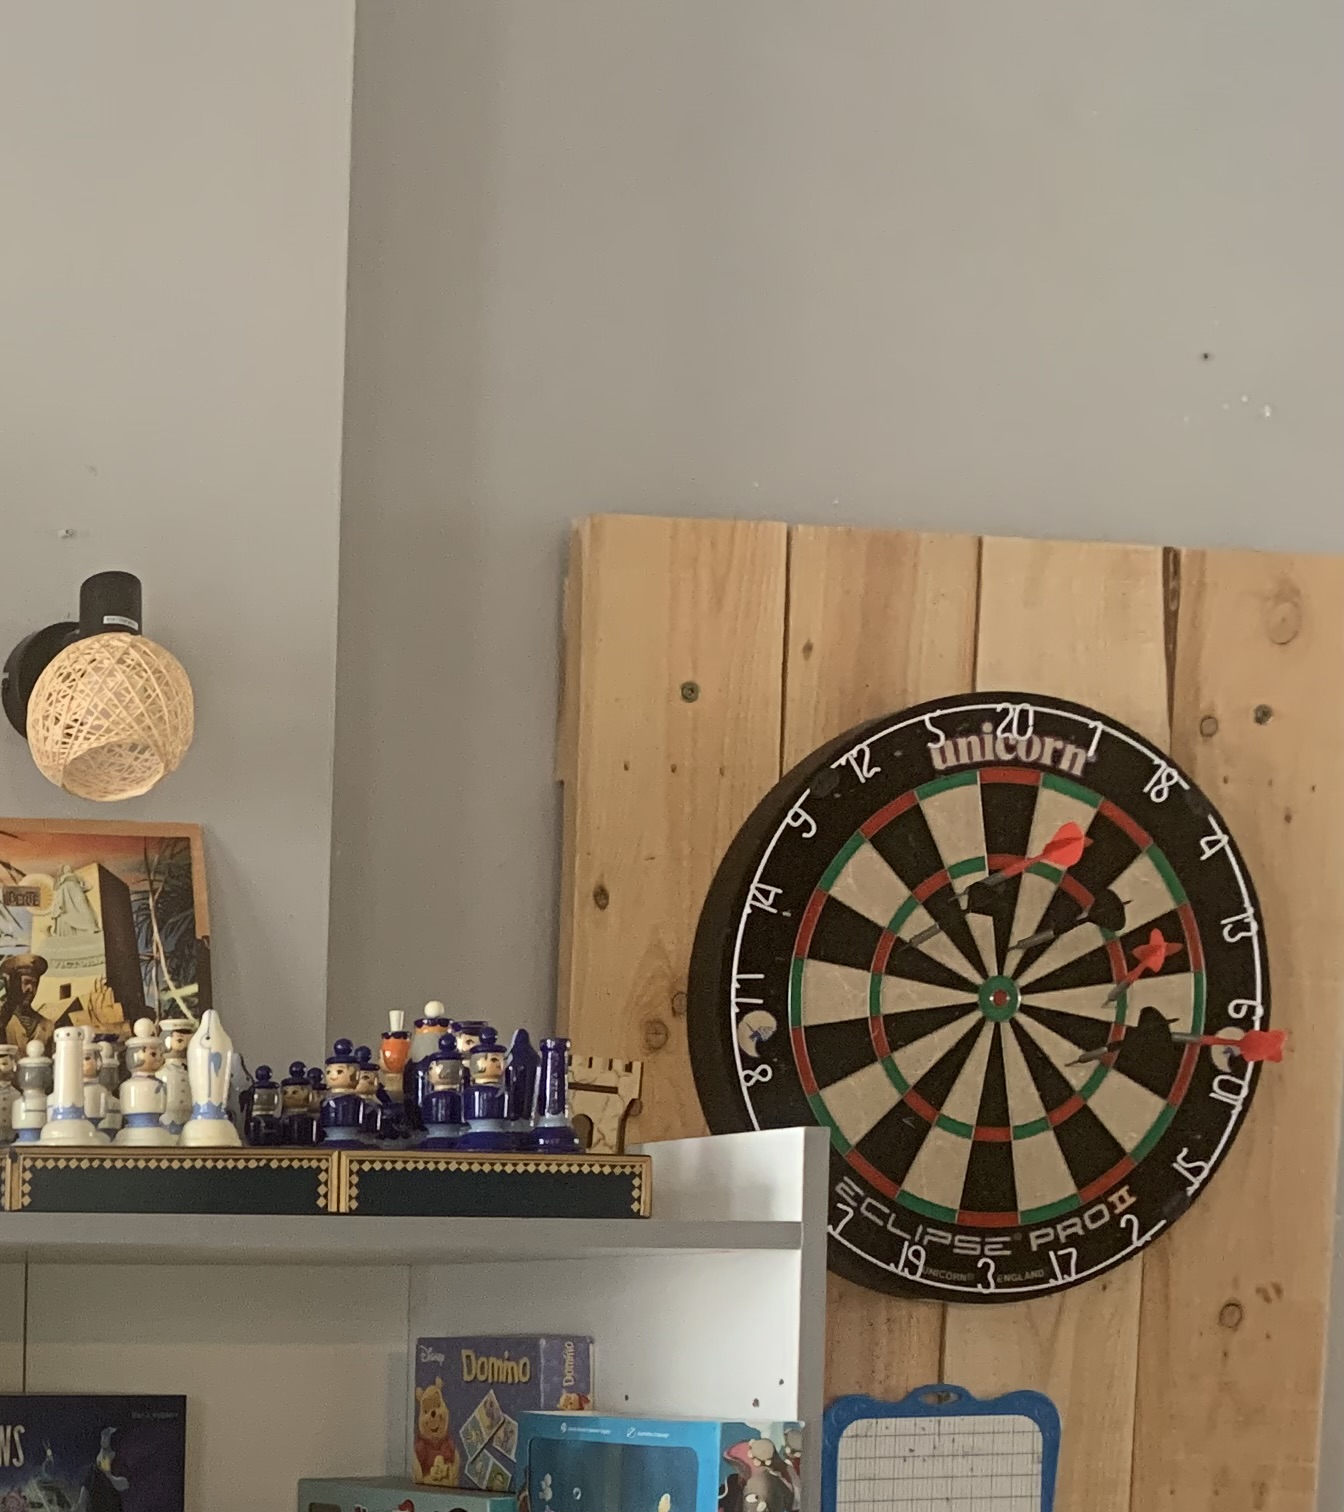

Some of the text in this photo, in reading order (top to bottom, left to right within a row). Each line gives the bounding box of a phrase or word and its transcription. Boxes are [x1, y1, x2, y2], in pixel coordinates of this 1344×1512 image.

[925, 712, 947, 748] 5
[996, 702, 1034, 741] 20
[929, 722, 1092, 776] unicorn
[1143, 761, 1180, 803] 18
[835, 1176, 1012, 1256] ECLIPSE
[1030, 1205, 1111, 1252] PRO
[976, 1257, 995, 1294] 3
[996, 1269, 1045, 1283] ENGLAND
[461, 1349, 531, 1385] Domino
